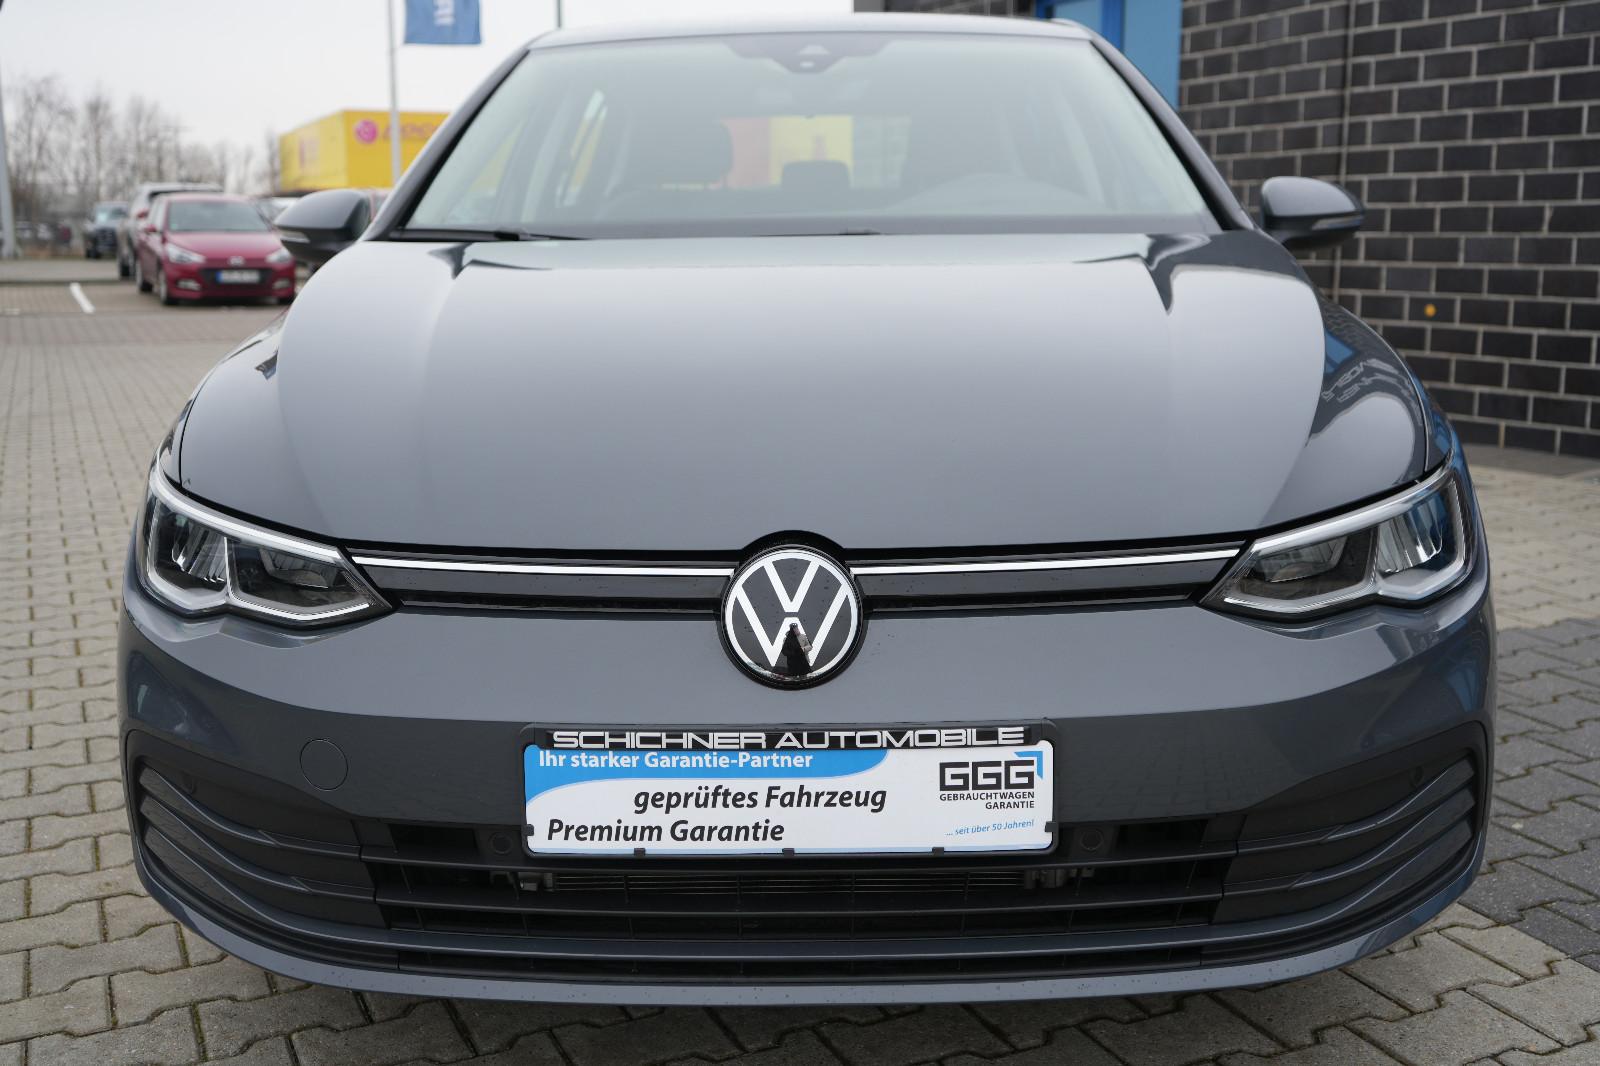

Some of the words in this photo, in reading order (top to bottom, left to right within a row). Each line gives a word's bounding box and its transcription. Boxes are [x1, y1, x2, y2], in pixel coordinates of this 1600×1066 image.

[553, 731, 767, 749] SCHICHNER
[775, 727, 1025, 749] AUTOMOBILE
[539, 751, 565, 767] Ihr
[570, 751, 638, 768] starker
[644, 751, 813, 768] Garantie-Partner
[939, 759, 1035, 791] GGG
[634, 785, 758, 815] geprüftes
[765, 785, 887, 813] Fahrzeug
[939, 791, 1035, 802] GEBRAUCHTWAGEN
[985, 800, 1035, 810] GARANTIE
[548, 819, 662, 842] Premium
[669, 819, 785, 842] Garantie
[955, 827, 970, 835] seit
[971, 825, 990, 833] über
[992, 823, 1003, 832] 50
[1004, 819, 1034, 831] Jahren!
